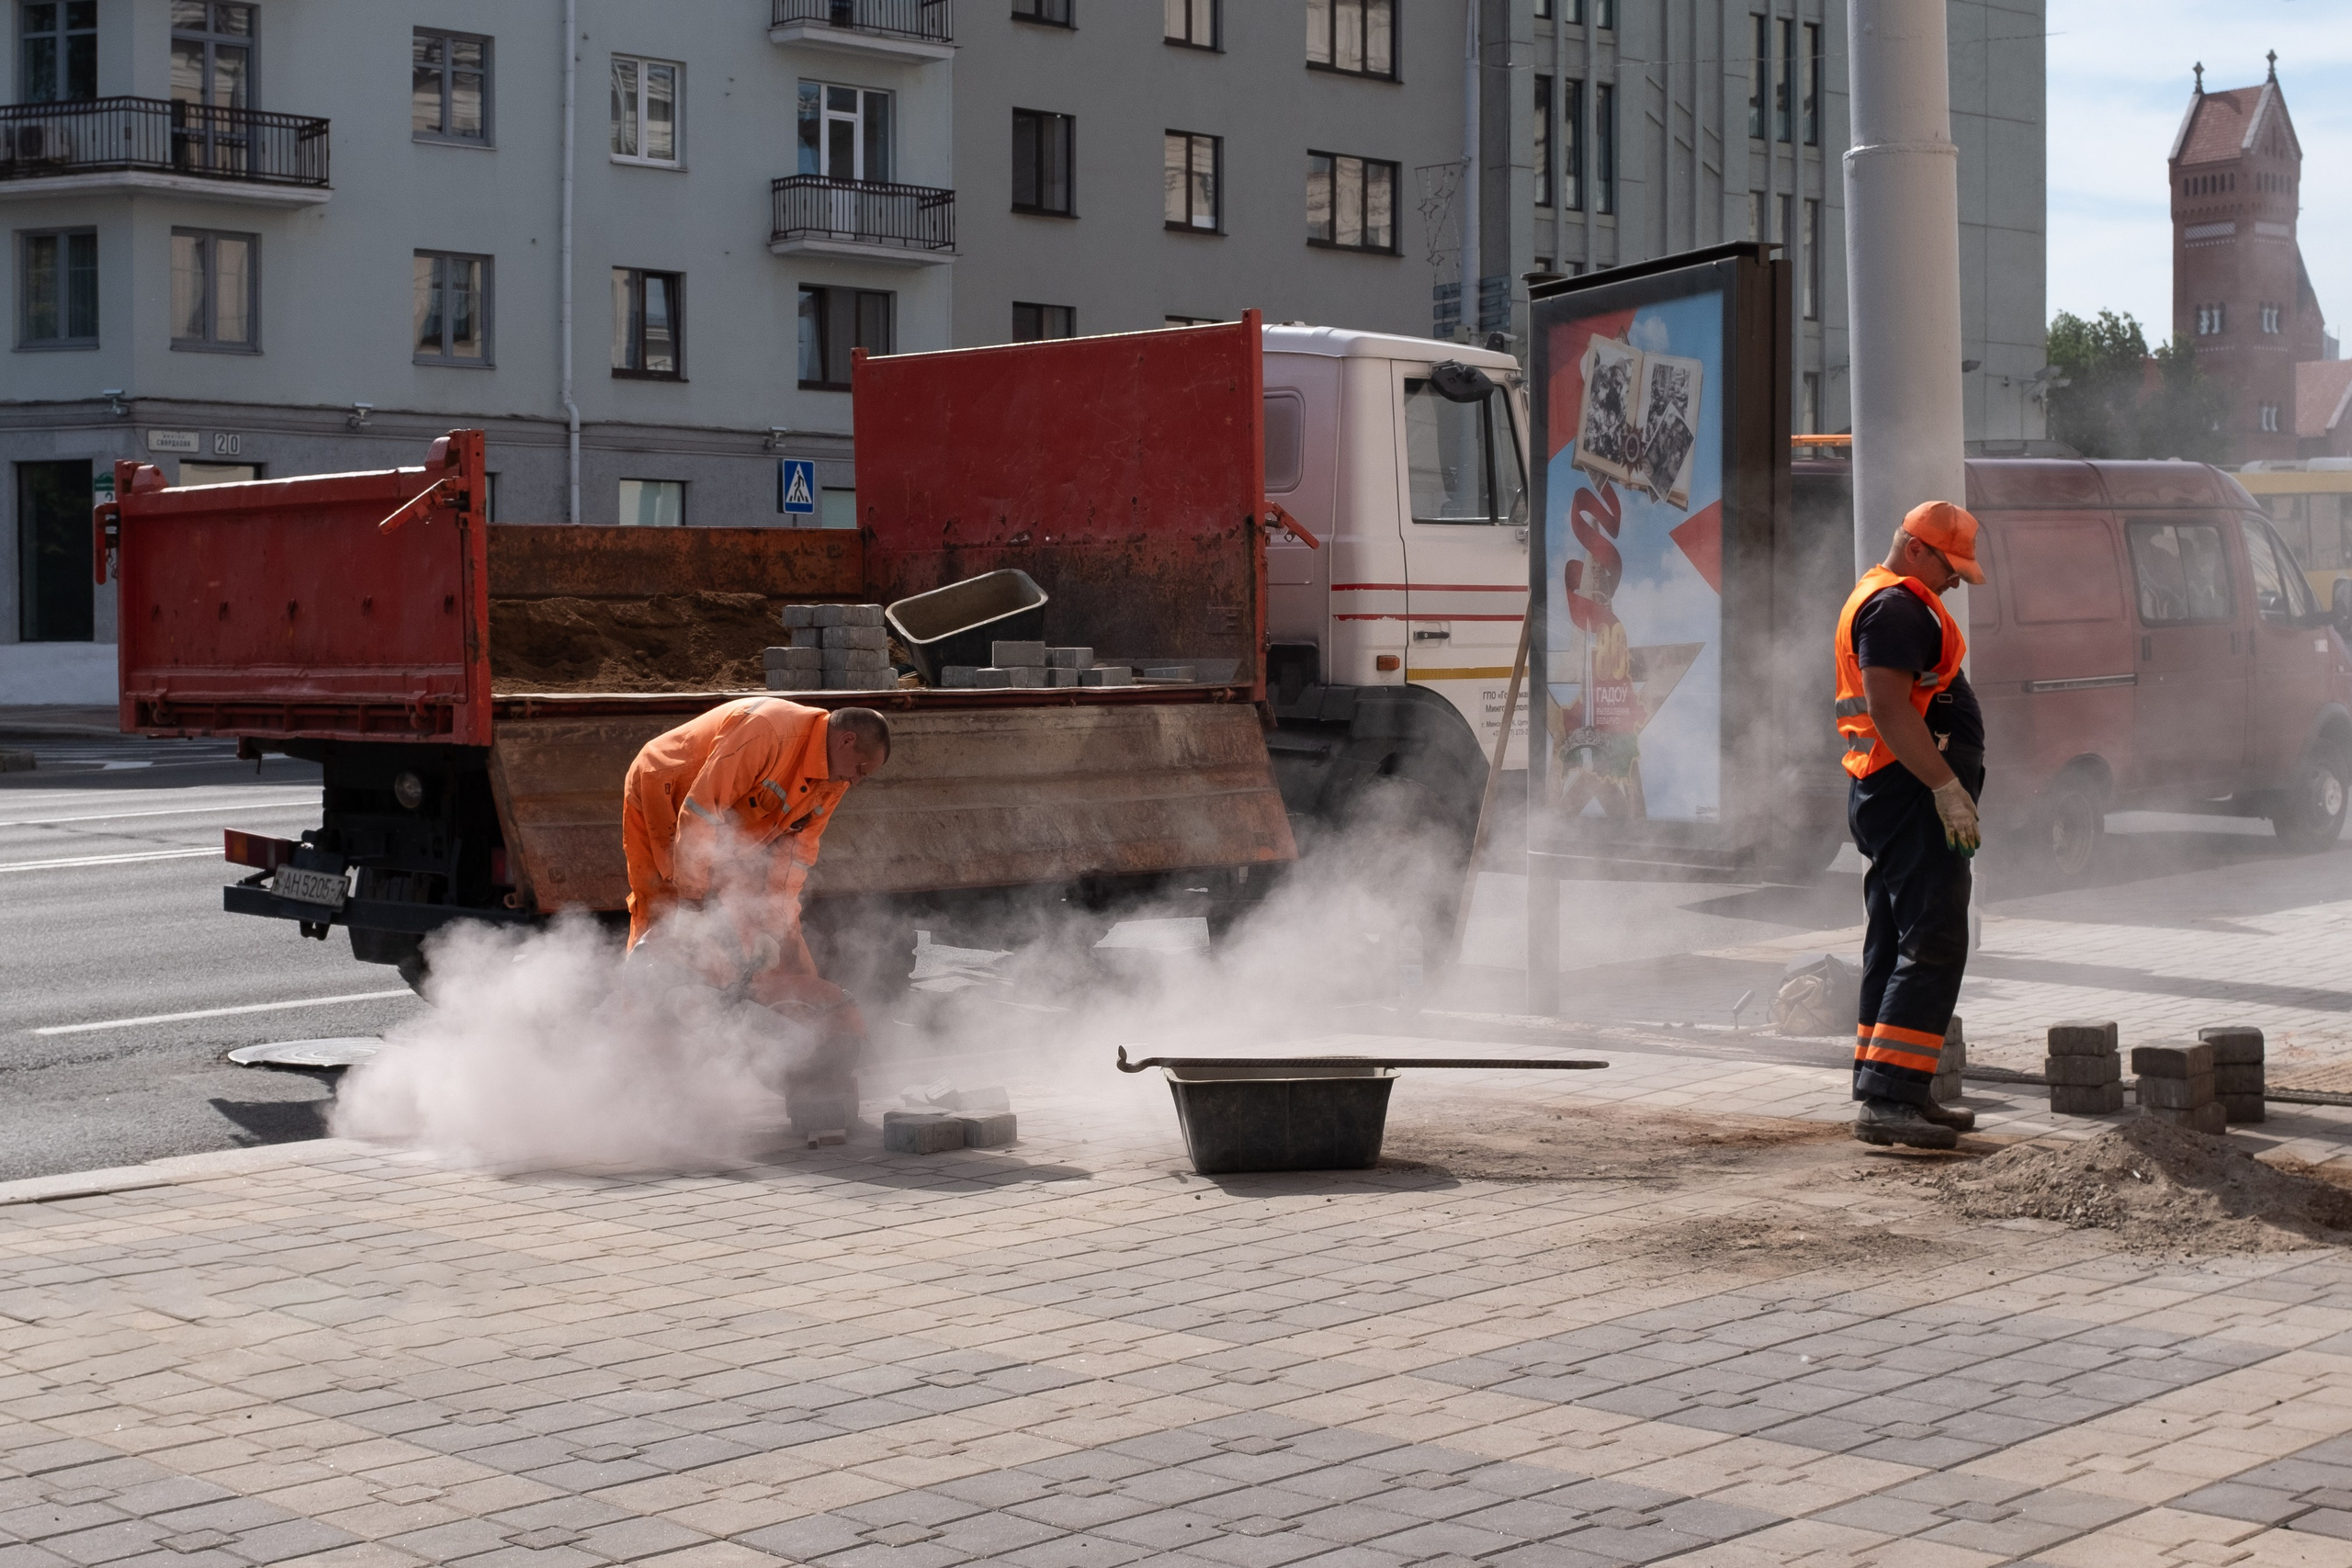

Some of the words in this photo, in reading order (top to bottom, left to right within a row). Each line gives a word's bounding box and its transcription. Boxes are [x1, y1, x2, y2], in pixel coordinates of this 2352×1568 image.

[217, 434, 238, 453] 20
[1483, 691, 1497, 700] ГПО
[1596, 683, 1628, 705] ГАДОЎ
